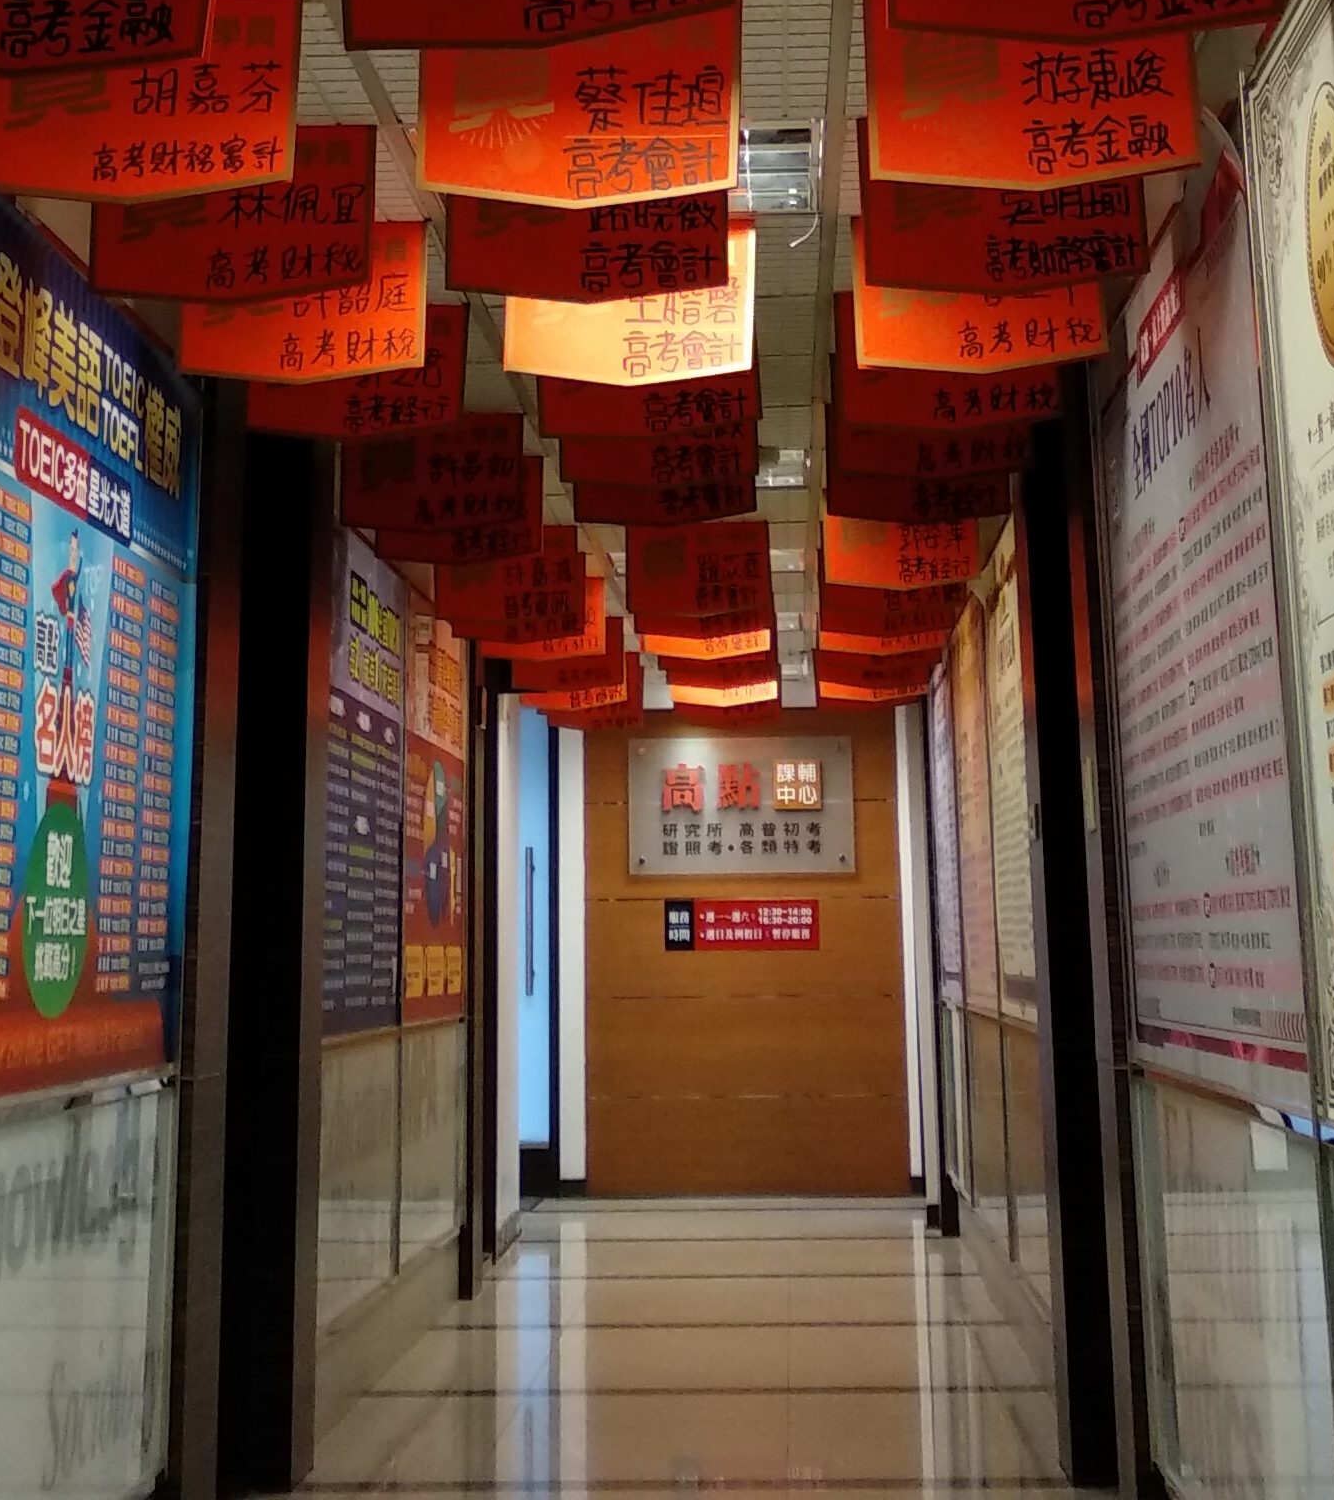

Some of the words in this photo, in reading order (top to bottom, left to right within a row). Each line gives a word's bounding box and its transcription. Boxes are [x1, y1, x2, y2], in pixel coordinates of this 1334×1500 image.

[563, 137, 721, 200] 高考會計
[1022, 115, 1176, 175] 高考金融
[205, 241, 364, 291] 高考財稅
[580, 242, 720, 294] 高考會計
[279, 329, 418, 373] 高考財稅
[622, 331, 743, 378] 高考會計
[957, 318, 1102, 359] 高考財稅
[104, 350, 149, 418] TOEIC
[101, 397, 146, 470] TOEFL
[642, 388, 748, 432] 高考會計
[650, 444, 743, 484] 高考會計
[662, 761, 760, 814] 高點
[662, 823, 723, 838] 研究所
